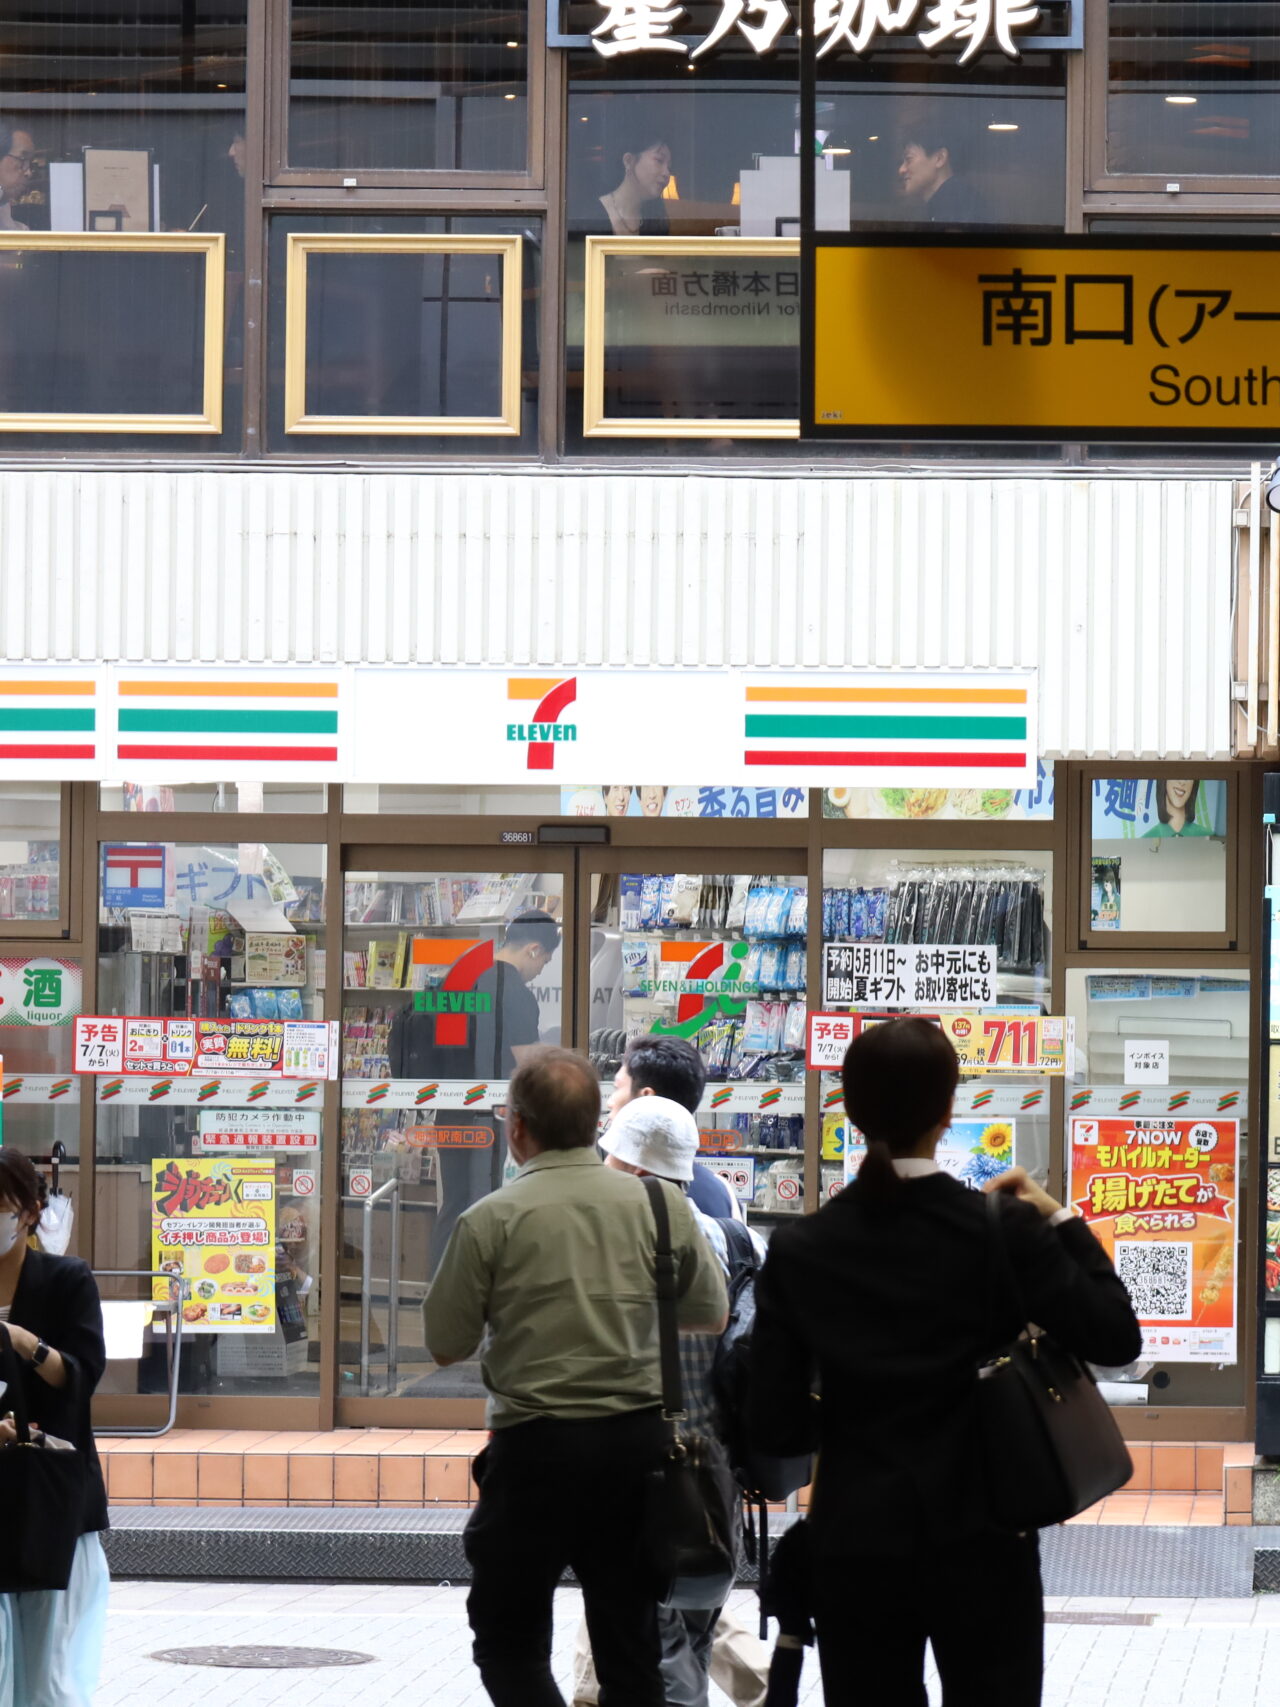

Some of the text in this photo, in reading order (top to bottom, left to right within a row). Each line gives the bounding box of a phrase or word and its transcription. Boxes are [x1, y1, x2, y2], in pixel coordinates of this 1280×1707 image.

[503, 832, 533, 843] 368681
[828, 949, 852, 971] 予約
[915, 950, 991, 975] お中元にも
[23, 968, 62, 1008] 酒
[641, 981, 678, 993] SEVEN
[696, 981, 760, 993] HOLDINGS
[828, 976, 991, 1002] 開始 夏ギフト お取り寄せにも
[27, 1010, 62, 1021] liquor
[81, 1024, 118, 1042] 予告
[814, 1022, 850, 1040] 予告
[80, 1044, 119, 1057] 7/7(火)
[226, 1037, 282, 1060] 無料!
[984, 1021, 1037, 1065] 711
[88, 1058, 109, 1067] から!
[1129, 1052, 1164, 1060] インボイス
[1134, 1061, 1159, 1069] 対象店
[216, 1112, 305, 1122] 防犯カメラ作動中
[1125, 1130, 1182, 1145] 7NOW
[1096, 1145, 1211, 1168] モバイルオーダー
[1091, 1177, 1214, 1214] 揚げたてが
[1114, 1213, 1196, 1236] 食べられる
[160, 1231, 268, 1244] イチ押し商品が登場!
